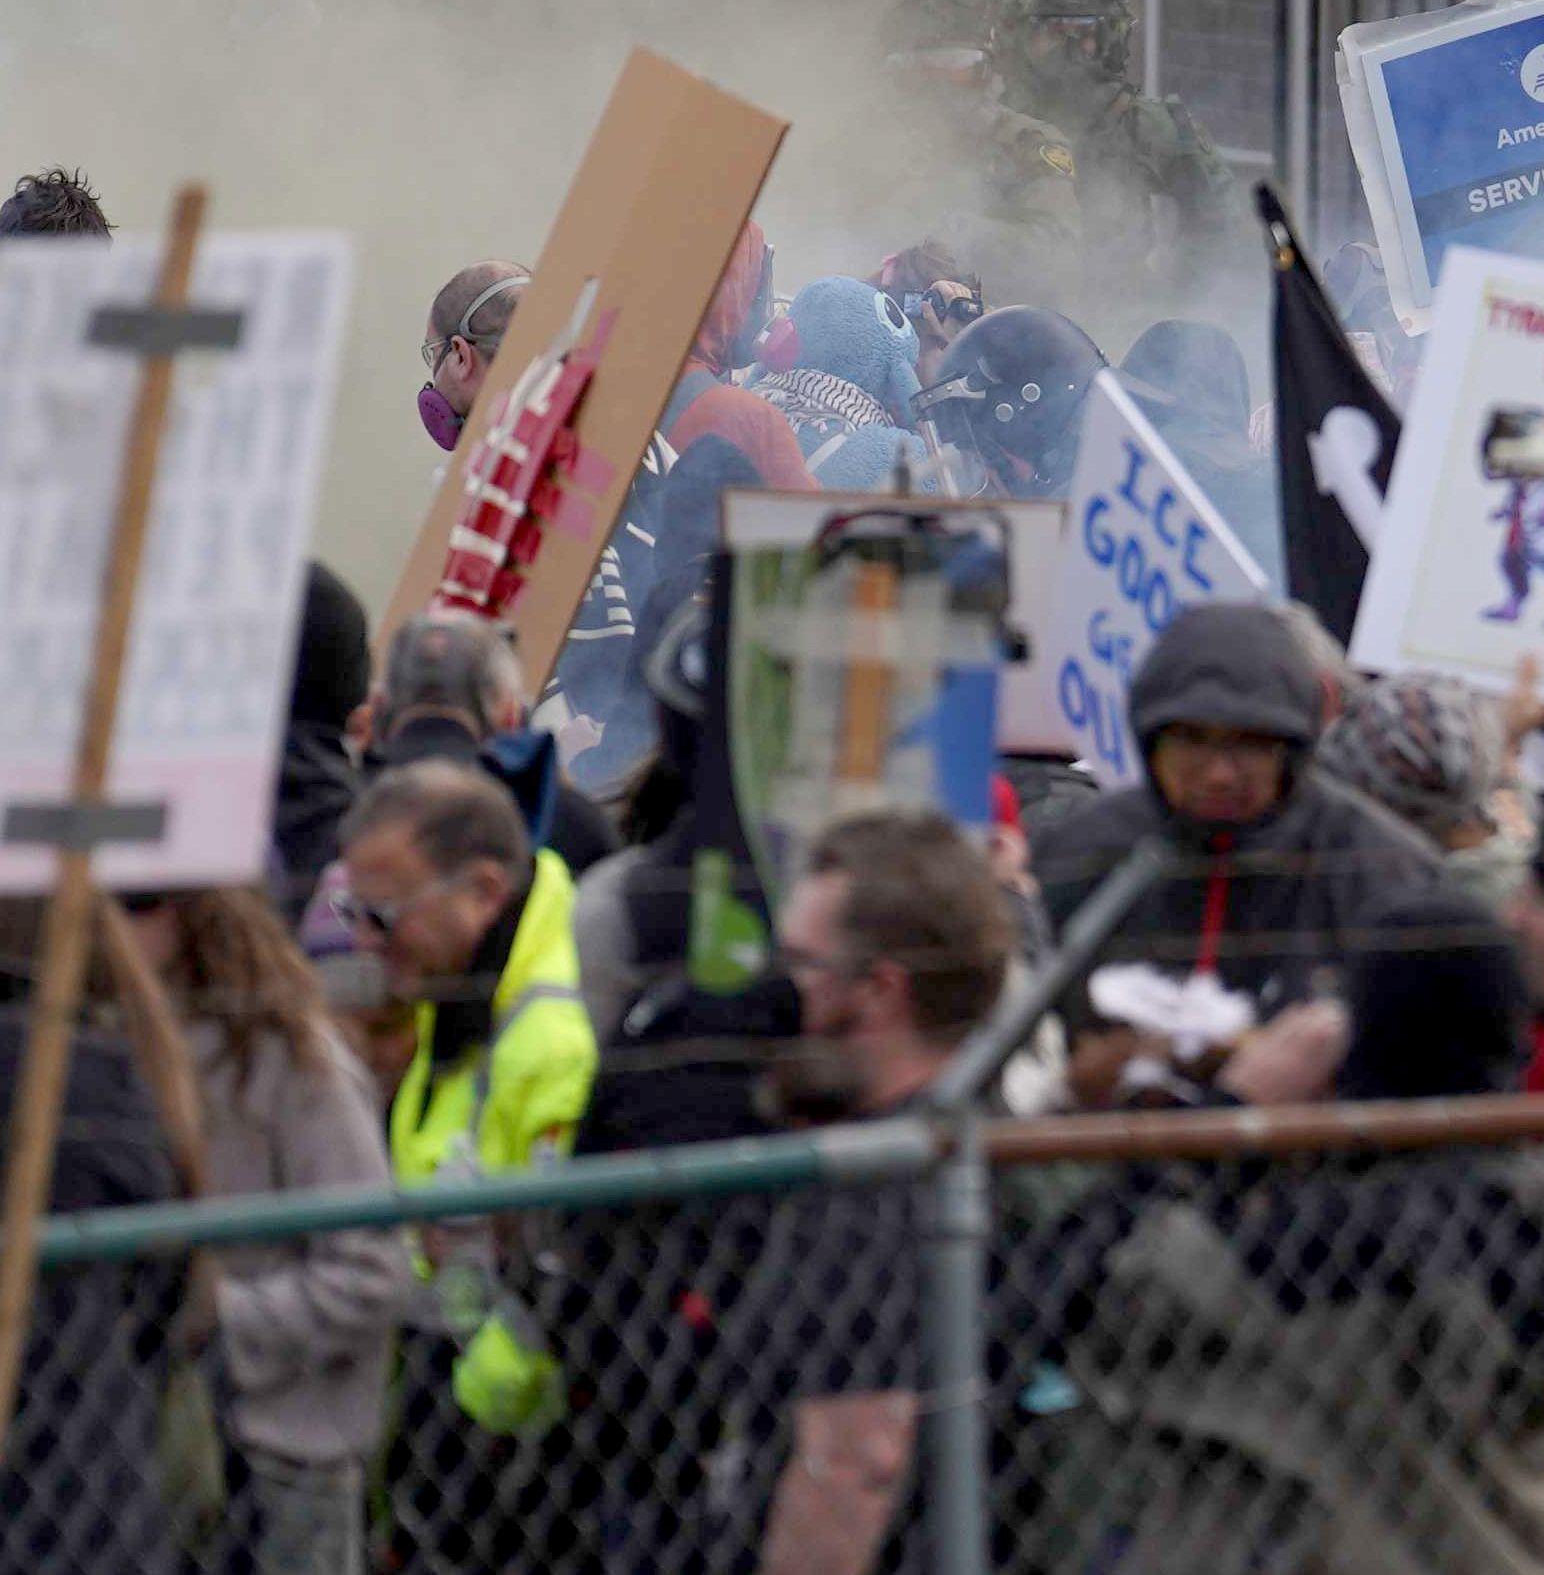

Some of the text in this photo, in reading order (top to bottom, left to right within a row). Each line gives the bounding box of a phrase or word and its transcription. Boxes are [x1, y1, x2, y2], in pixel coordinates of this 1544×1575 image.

[1083, 493, 1182, 636] GOO
[1116, 436, 1213, 592] ICE
[1059, 654, 1125, 776] OU
